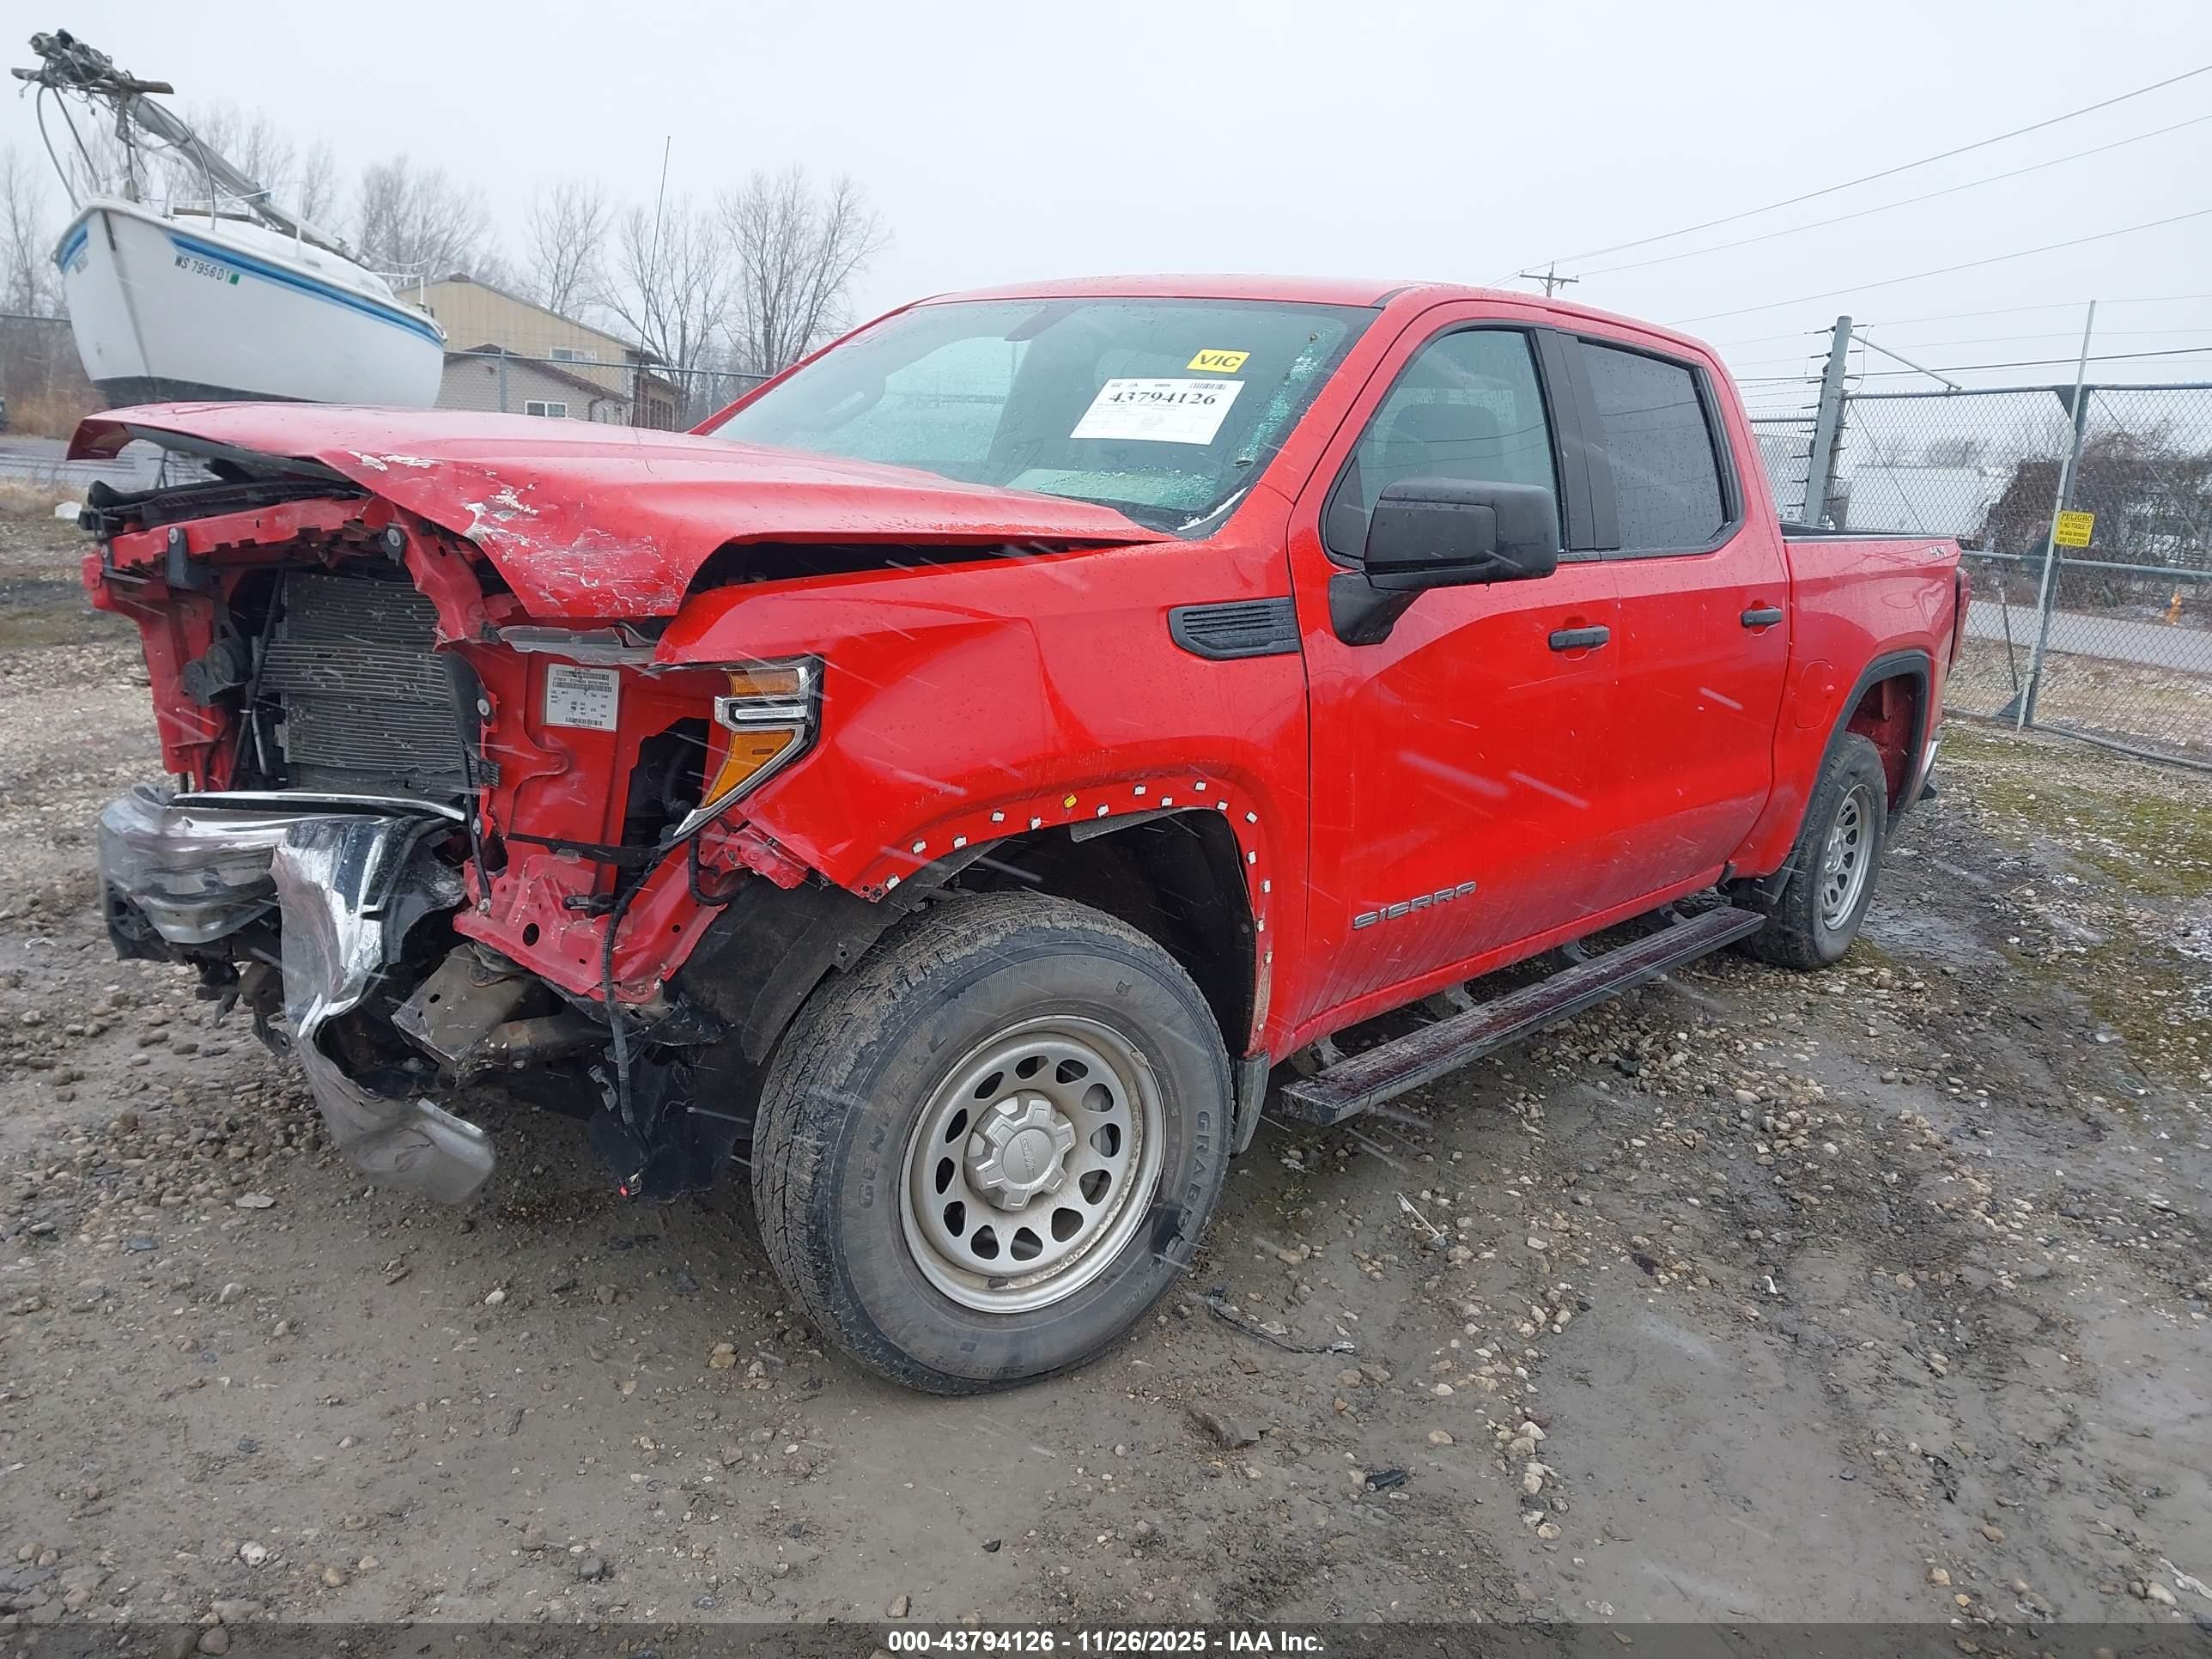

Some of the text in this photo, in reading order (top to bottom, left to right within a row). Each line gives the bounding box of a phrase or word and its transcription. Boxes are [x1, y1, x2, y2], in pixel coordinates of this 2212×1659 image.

[174, 254, 190, 269] WS
[1200, 354, 1241, 368] VIC
[1109, 391, 1217, 405] 43794126
[2061, 513, 2093, 522] PELIGRO
[1352, 880, 1477, 930] SIERRA
